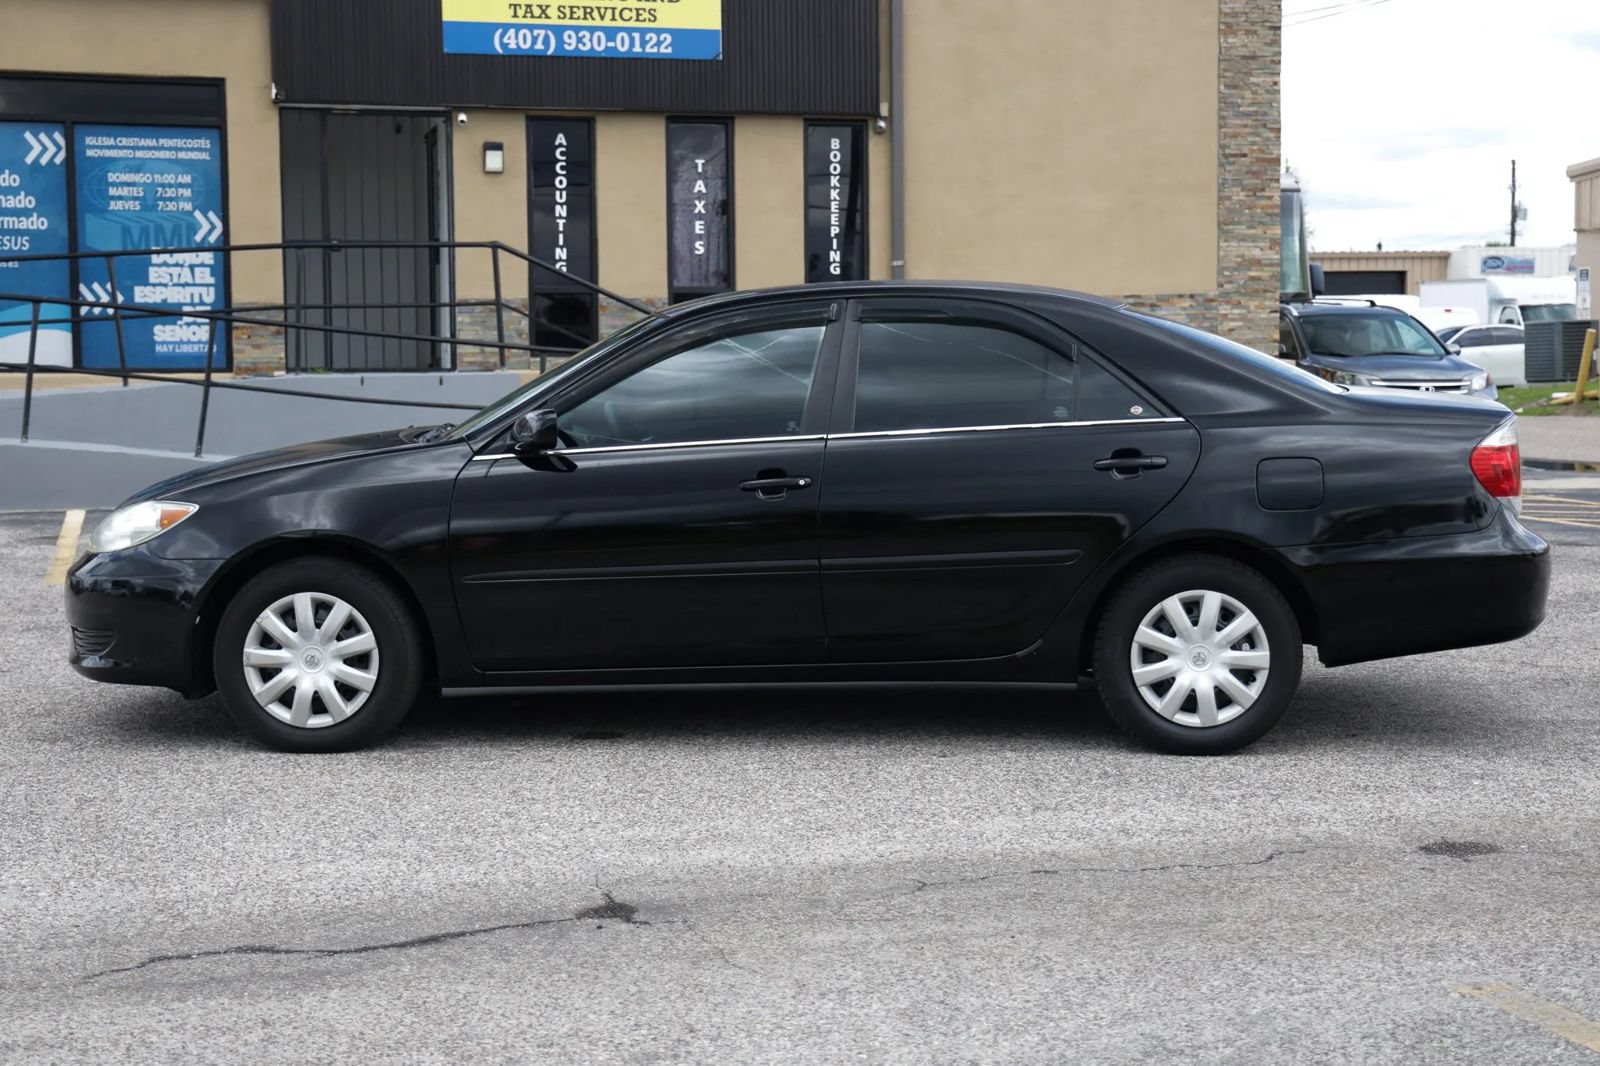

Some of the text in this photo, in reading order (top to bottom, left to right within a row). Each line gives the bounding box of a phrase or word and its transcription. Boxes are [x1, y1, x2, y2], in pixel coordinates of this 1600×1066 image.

[509, 3, 657, 23] TAX SERVICES
[493, 28, 673, 55] (407) 930-0122
[85, 136, 116, 146] IGLESIA
[116, 137, 157, 147] CRISTIANA
[86, 149, 211, 160] MOVIMIENTO MISIONERO MUNDIAL
[108, 172, 192, 183] DOMINGO 11:00 AM
[108, 187, 192, 197] MARTES 7:30 PM
[108, 200, 193, 211] JUEVES 7:30 PM
[554, 133, 567, 273] ACCOUNTING
[693, 159, 707, 254] TAXES
[829, 138, 841, 275] BOOKKEEPING
[193, 266, 215, 284] EL
[155, 343, 174, 353] HAY
